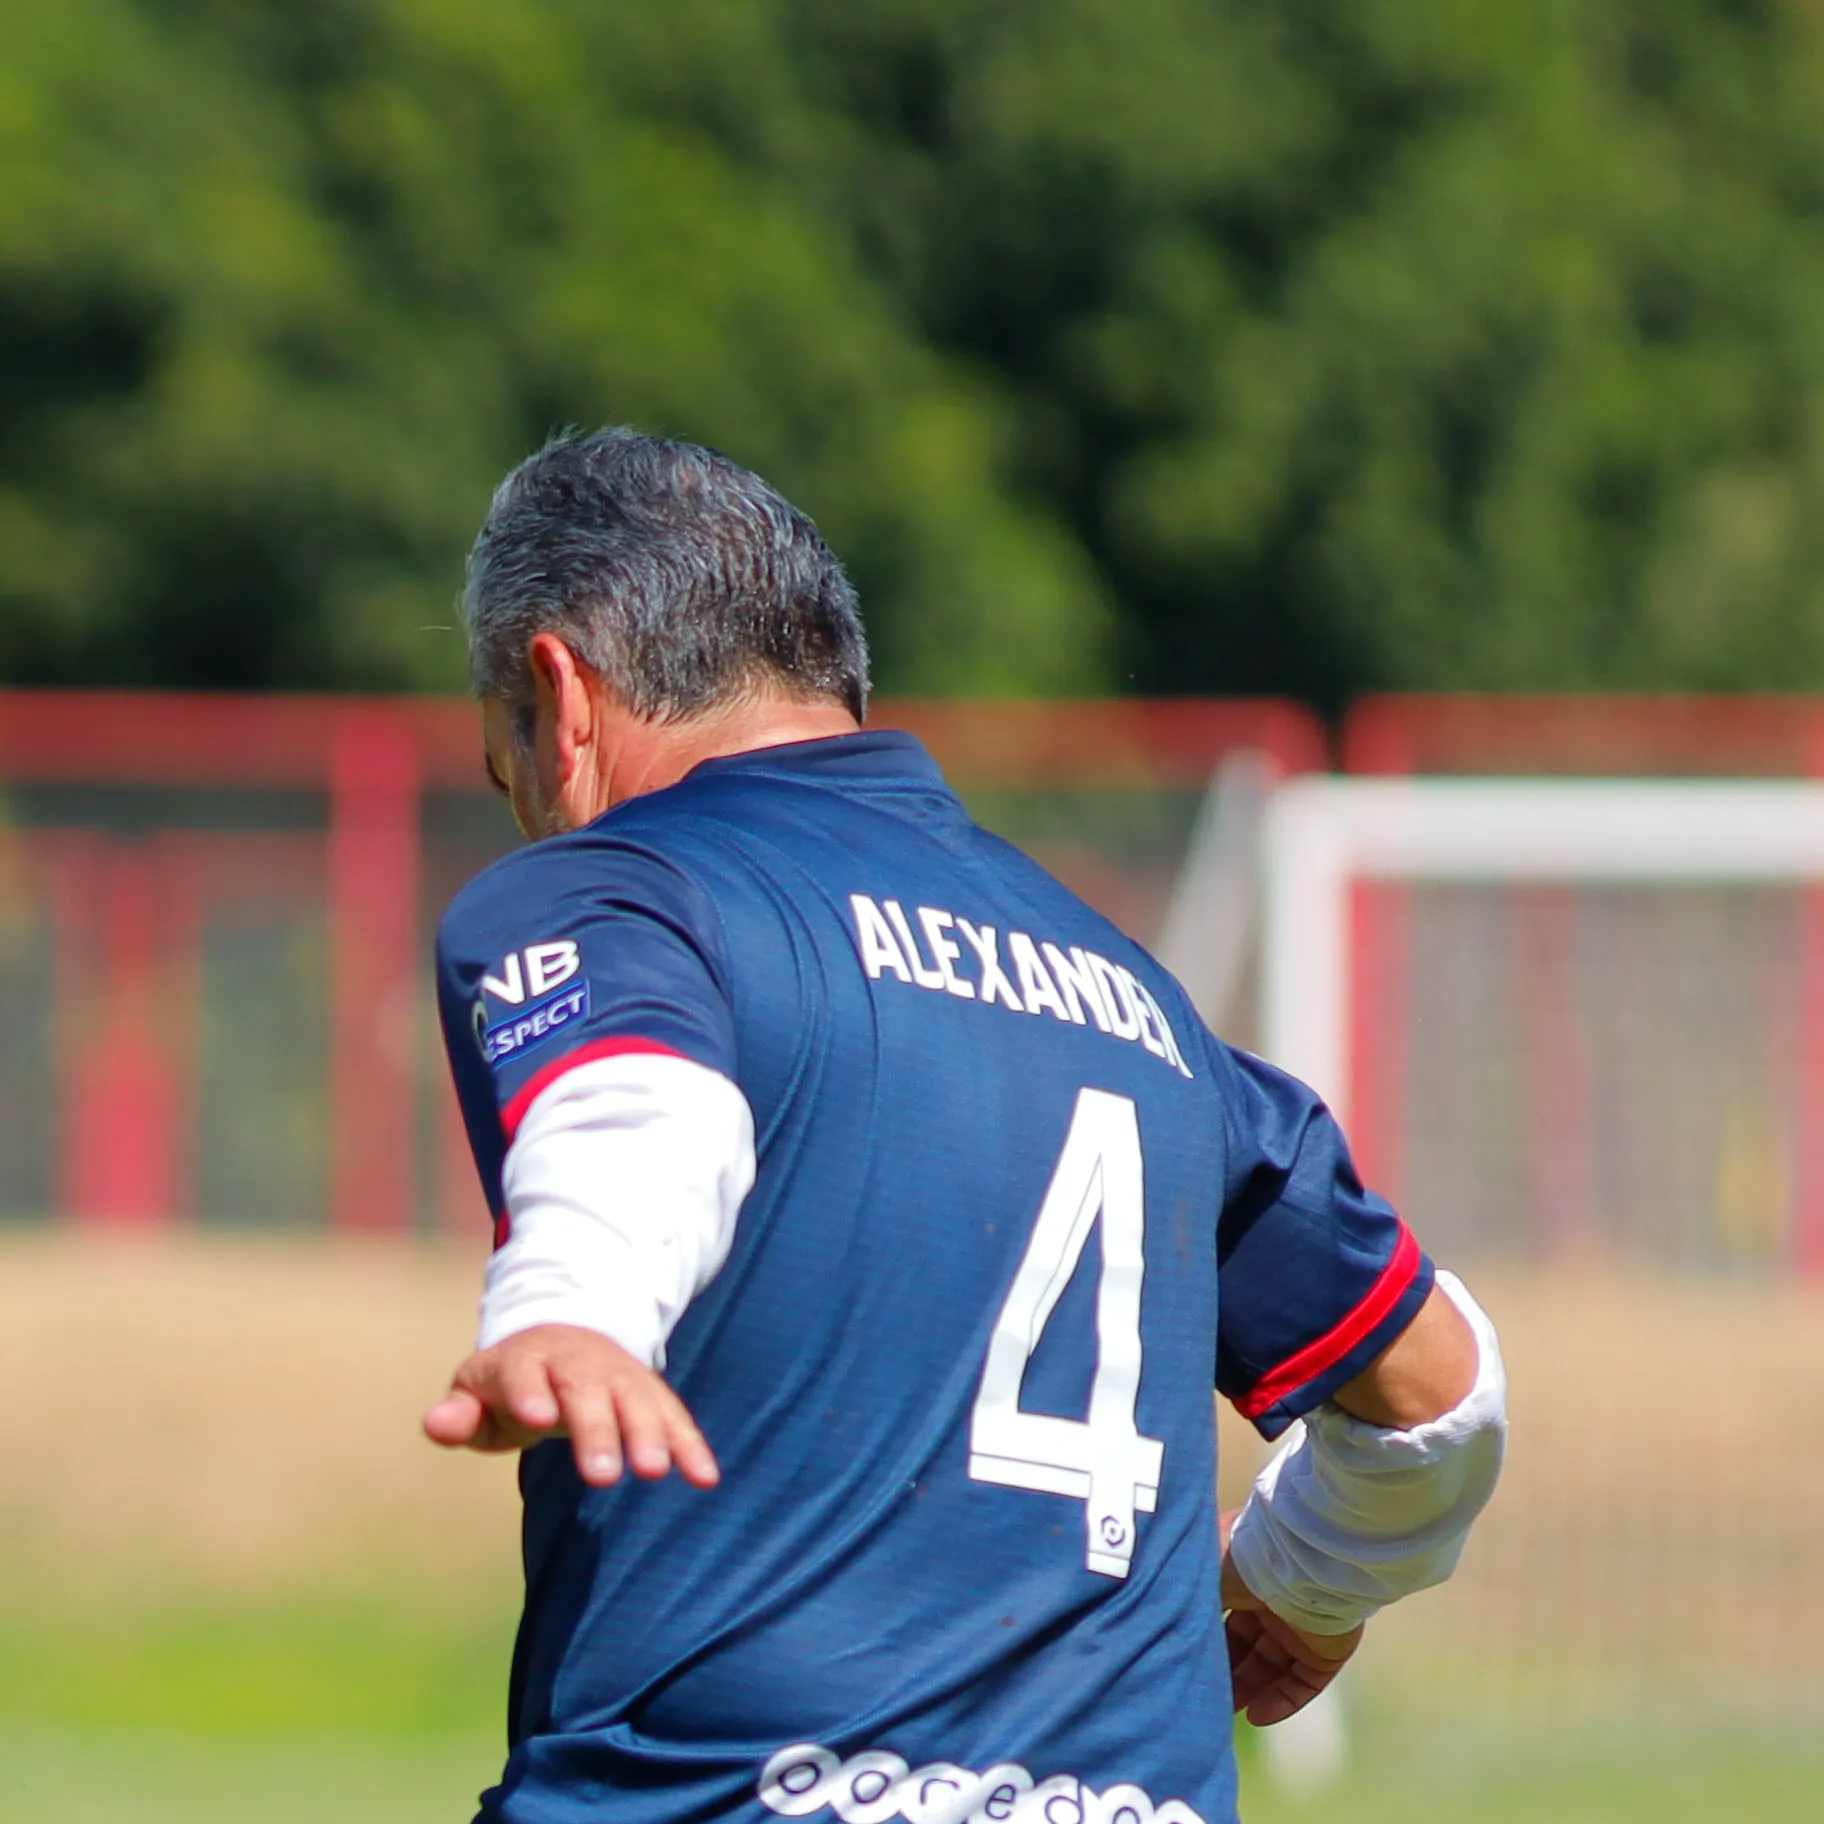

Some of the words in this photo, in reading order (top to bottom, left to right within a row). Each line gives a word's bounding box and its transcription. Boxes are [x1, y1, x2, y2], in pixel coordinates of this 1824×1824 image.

[485, 990, 586, 1061] ESPECT
[850, 893, 1194, 1079] ALEXANDER
[968, 1087, 1164, 1579] 4
